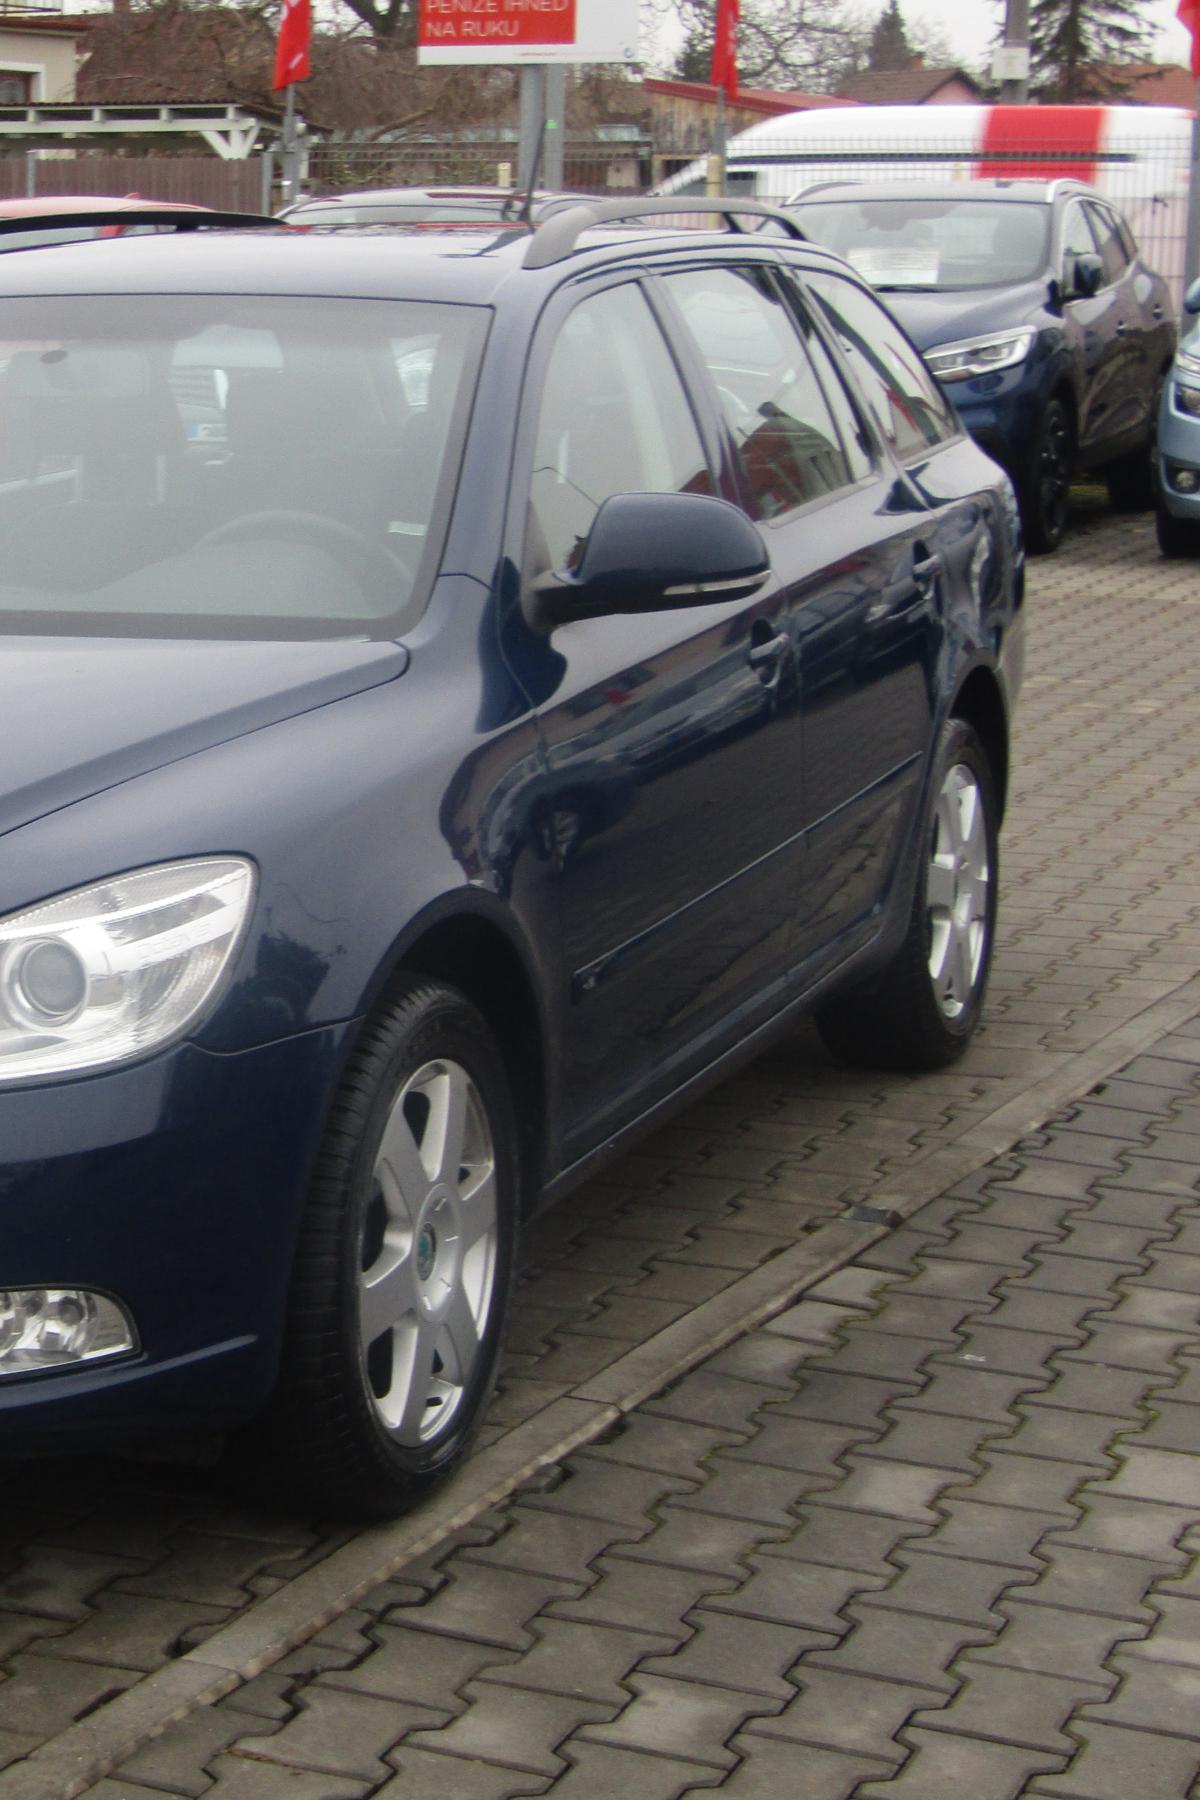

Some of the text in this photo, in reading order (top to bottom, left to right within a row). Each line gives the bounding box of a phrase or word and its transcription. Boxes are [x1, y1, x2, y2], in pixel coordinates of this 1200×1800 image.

[504, 0, 569, 12] IHNED
[426, 20, 519, 37] NA RUKU
